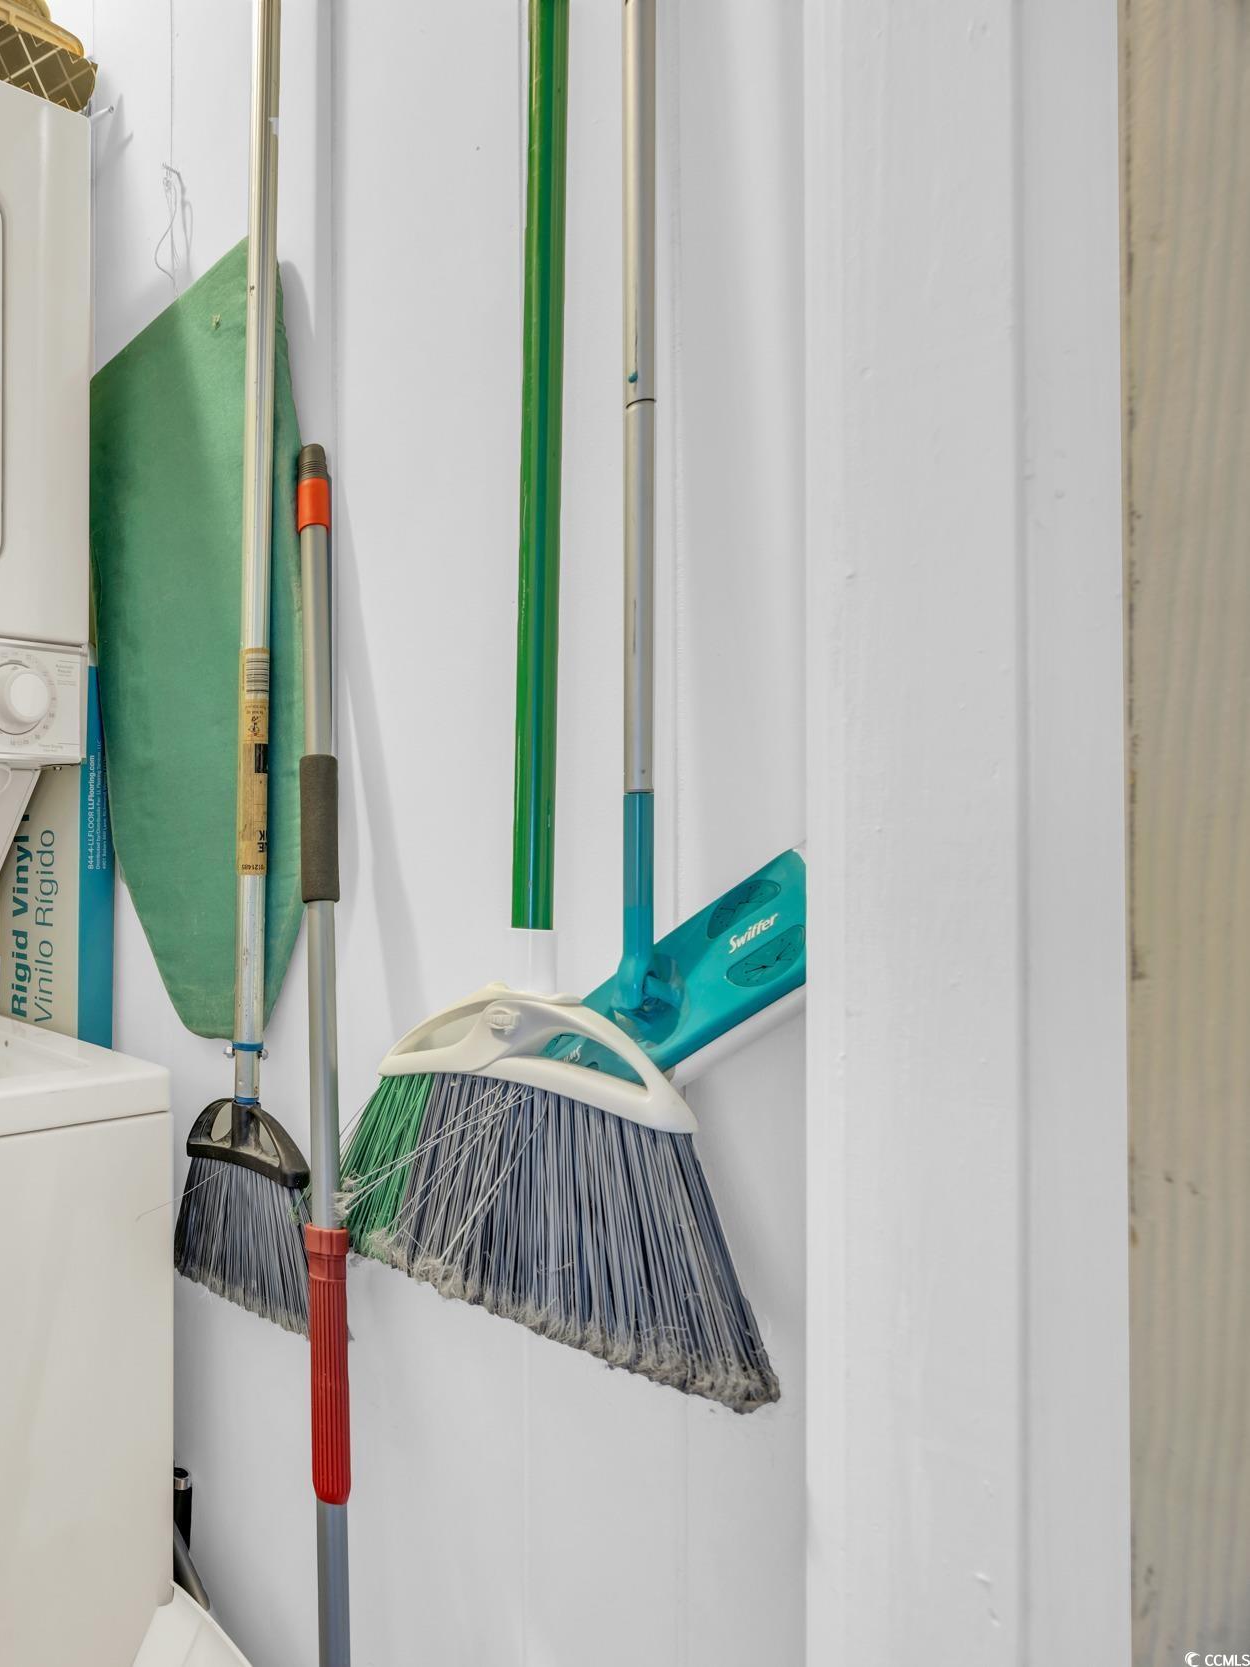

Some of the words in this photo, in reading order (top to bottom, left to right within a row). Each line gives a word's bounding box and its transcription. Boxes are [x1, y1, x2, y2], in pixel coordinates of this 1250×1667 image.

[87, 755, 97, 810] LLFlooring.com
[12, 834, 33, 918] Vinyl
[35, 829, 59, 927] Rígido
[11, 929, 32, 1019] Rigid
[728, 912, 779, 954] Swiffer
[34, 940, 54, 1023] Vinilo
